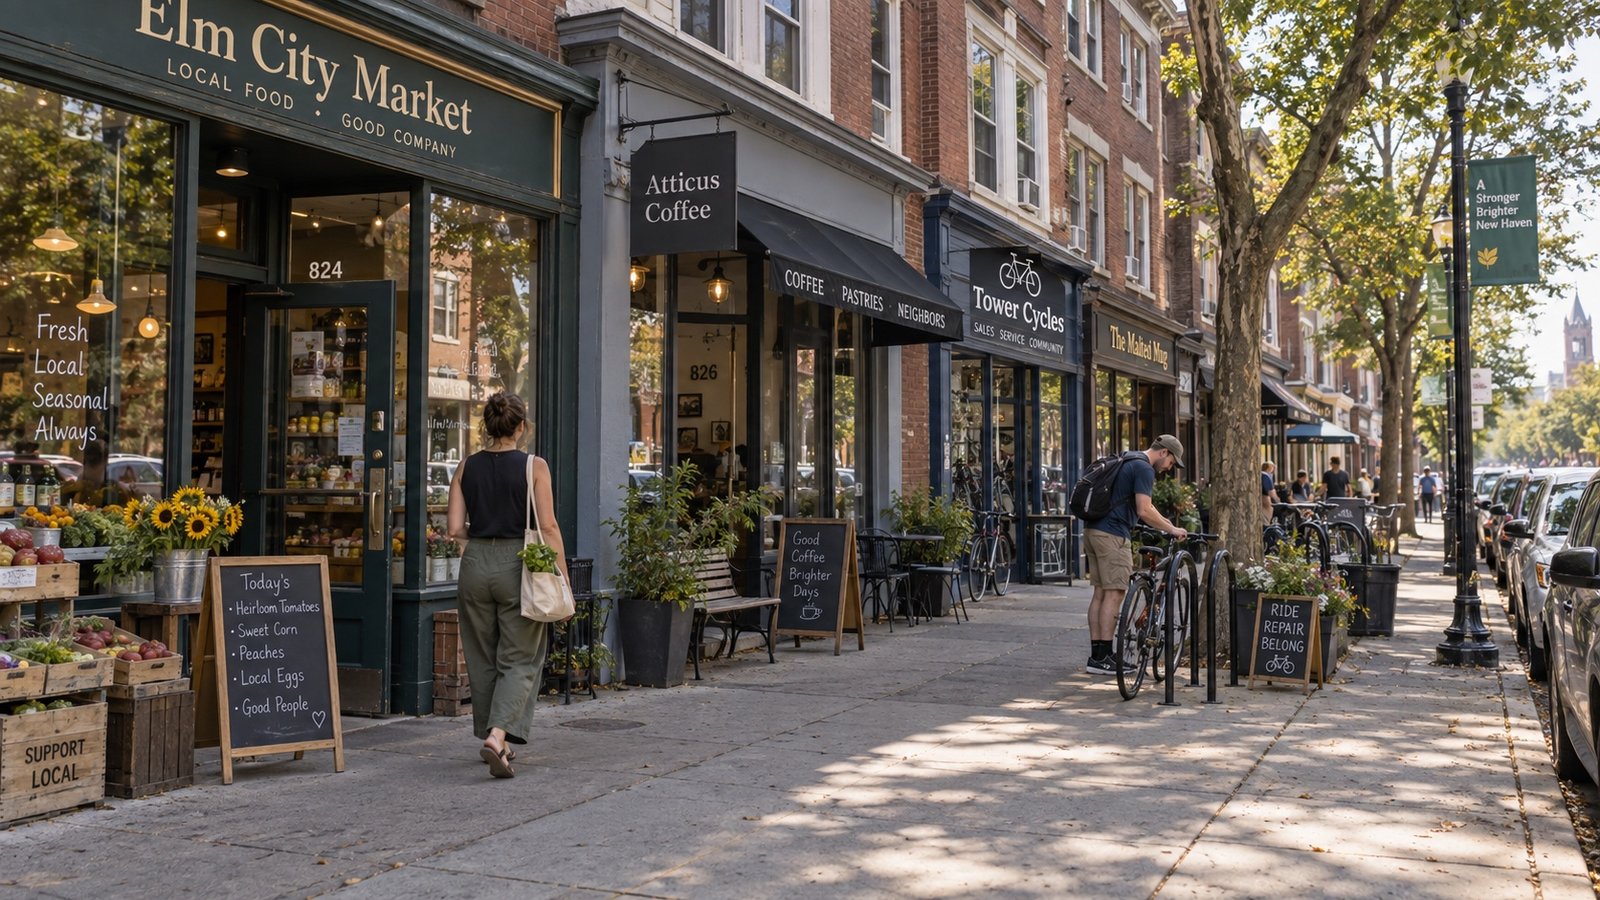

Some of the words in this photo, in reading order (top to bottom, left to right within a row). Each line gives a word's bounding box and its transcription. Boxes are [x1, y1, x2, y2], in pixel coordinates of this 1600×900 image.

[135, 0, 236, 62] Elm
[251, 23, 340, 102] City
[352, 55, 472, 135] Market
[167, 58, 232, 93] LOCAL
[245, 83, 294, 110] FOOD
[341, 113, 385, 137] GOOD
[394, 129, 456, 158] COMPANY
[645, 171, 720, 196] Atticus
[1476, 179, 1486, 190] A
[1476, 193, 1520, 204] Stronger
[645, 200, 711, 223] Coffee
[1476, 205, 1519, 218] Brighter
[1476, 220, 1498, 230] New
[1501, 218, 1533, 228] Haven
[308, 260, 343, 280] 824
[785, 268, 824, 296] COFFEE
[842, 285, 884, 312] PASTRIES
[898, 302, 946, 329] NEIGHBORS
[973, 285, 1019, 320] Tower
[1023, 301, 1064, 333] Cycles
[37, 313, 89, 342] Fresh
[974, 322, 995, 337] SALES
[1000, 329, 1025, 345] SERVICE
[1110, 325, 1126, 351] The
[34, 348, 84, 376] Local
[690, 364, 718, 381] 826
[32, 382, 108, 410] Seasonal
[34, 415, 97, 451] Always
[793, 530, 820, 546] Good
[791, 549, 825, 563] Coffee
[240, 572, 290, 597] Today's
[789, 567, 832, 585] Brighter
[793, 585, 820, 601] Days
[235, 600, 278, 616] Heirloom
[278, 599, 320, 614] Tomatoes
[1271, 603, 1300, 618] RIDE
[237, 623, 269, 638] Sweet
[273, 622, 298, 636] Corn
[1264, 620, 1304, 636] REPAIR
[239, 645, 285, 661] Peaches
[1261, 636, 1304, 653] BELONG
[241, 668, 271, 686] Local
[277, 667, 305, 689] Eggs
[242, 697, 271, 717] Good
[275, 695, 309, 717] People
[25, 738, 86, 765] SUPPORT
[31, 763, 79, 789] LOCAL
